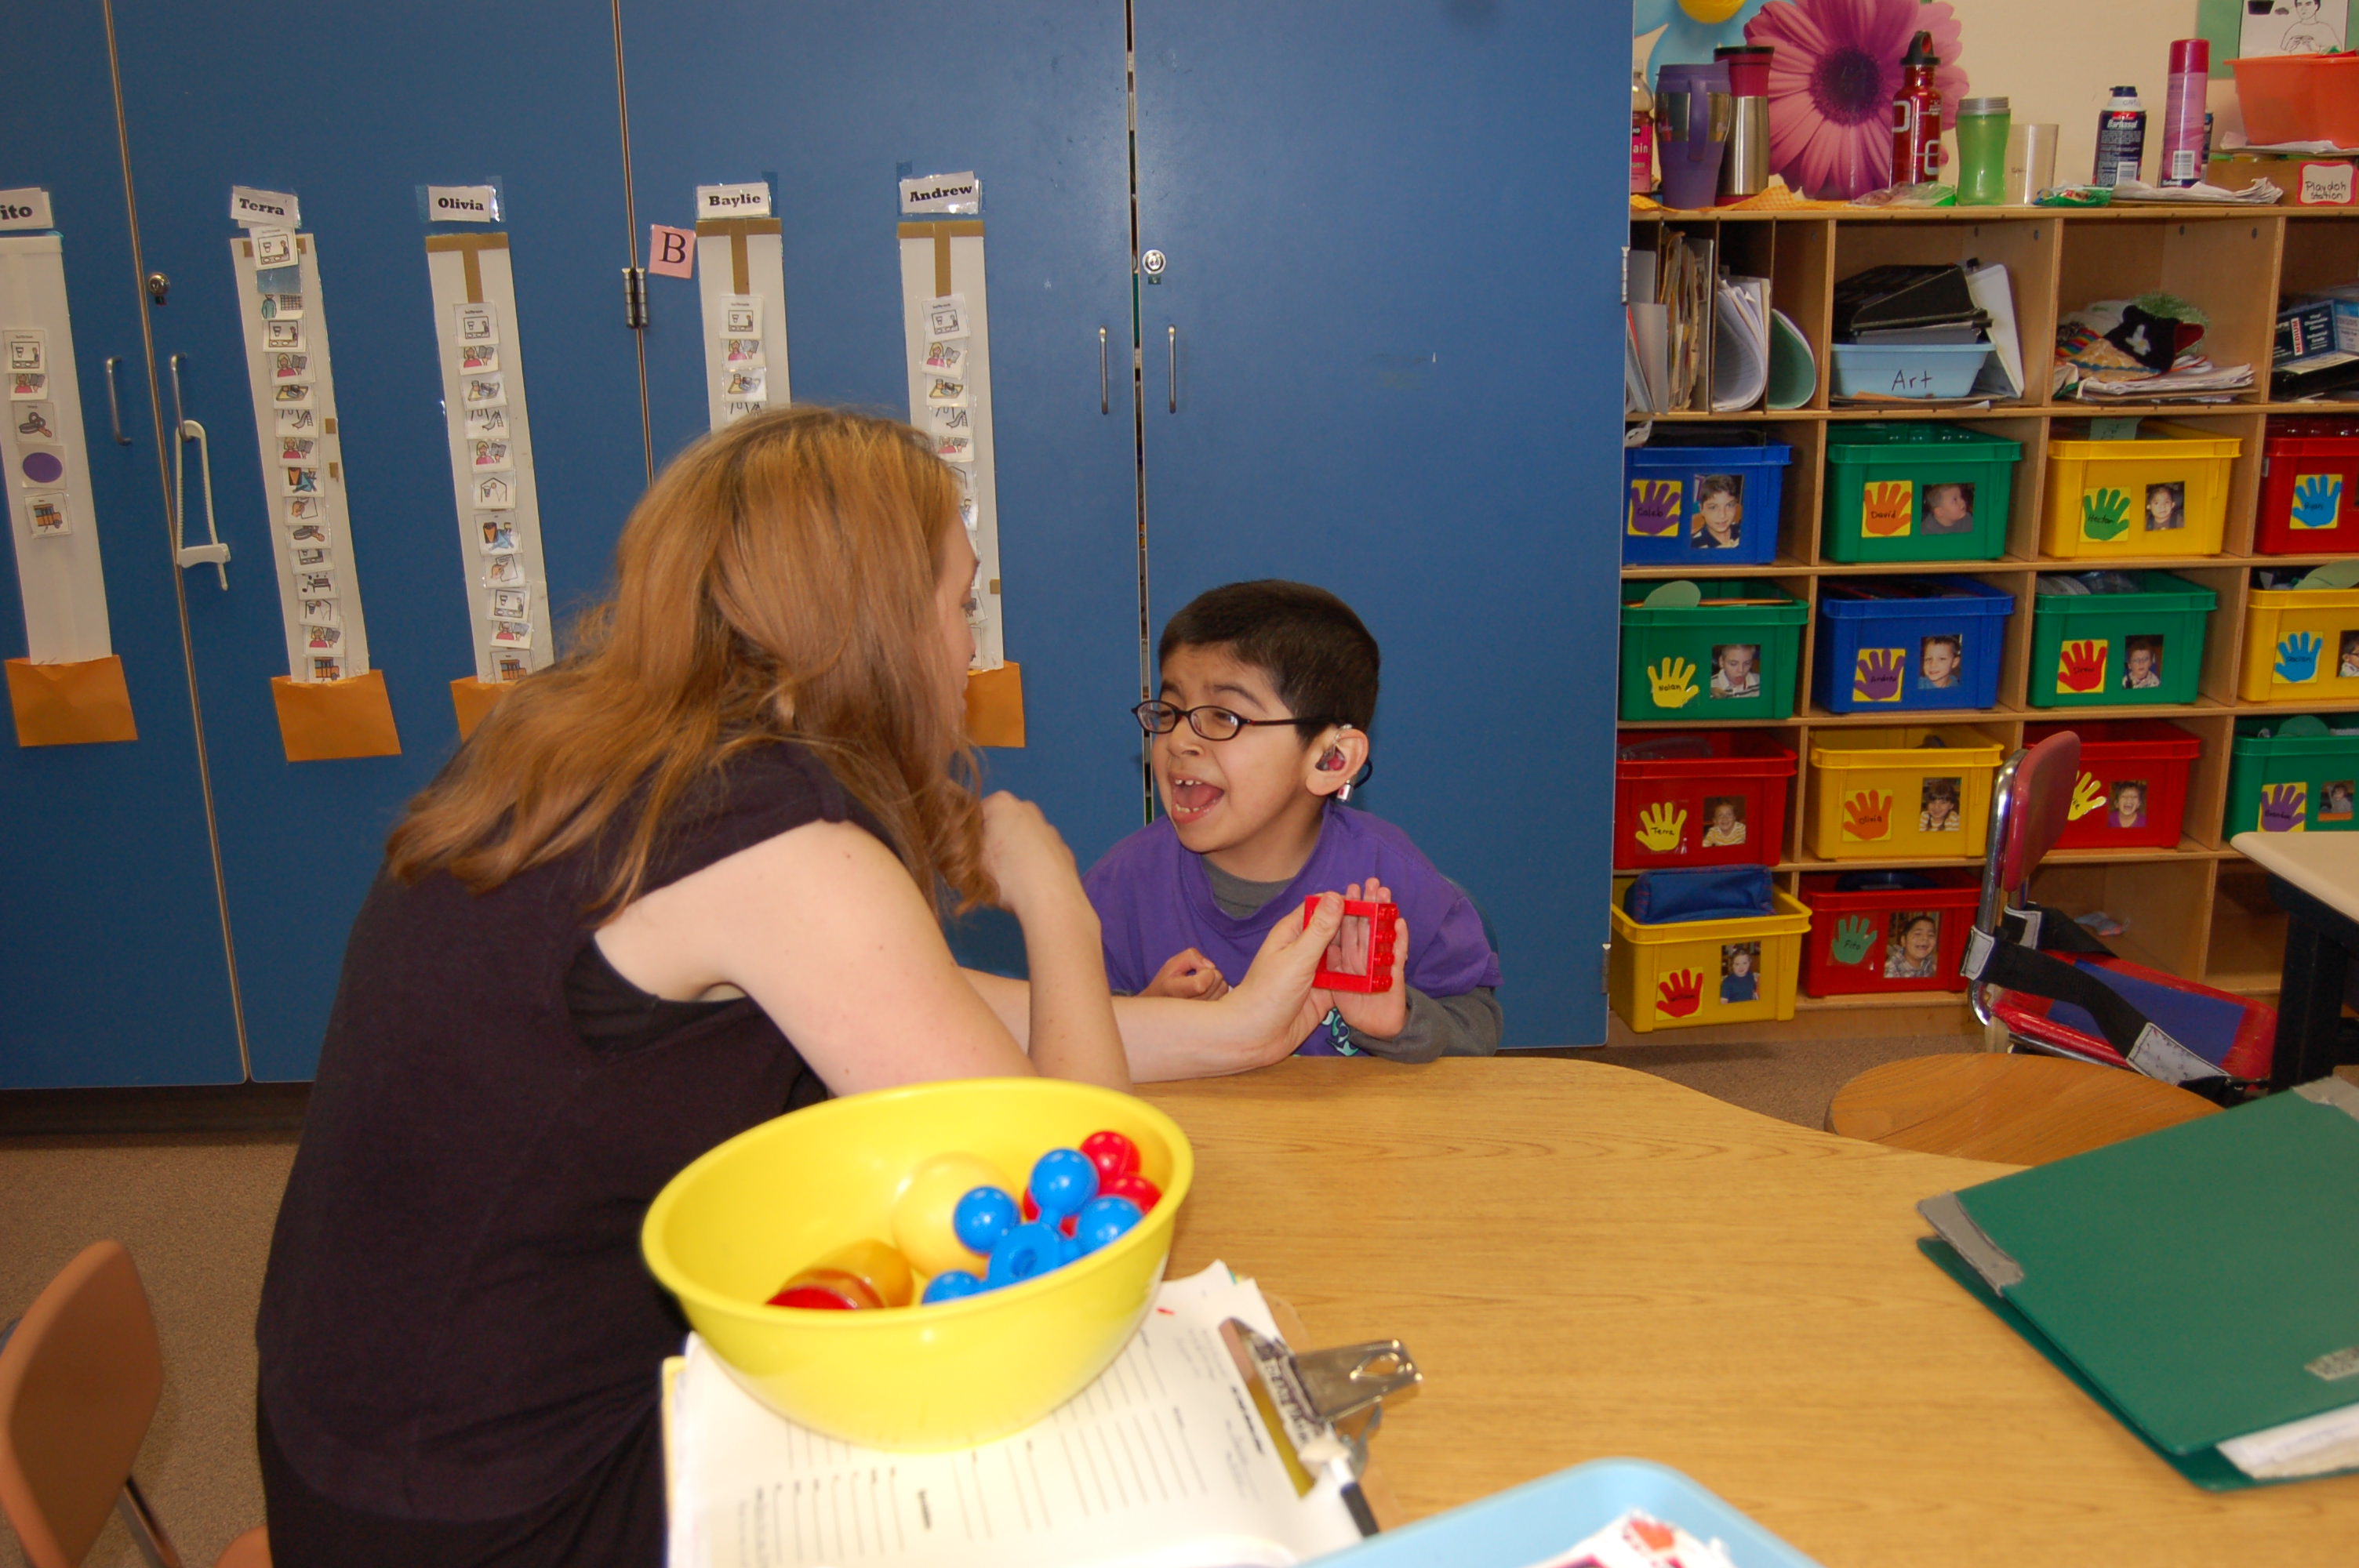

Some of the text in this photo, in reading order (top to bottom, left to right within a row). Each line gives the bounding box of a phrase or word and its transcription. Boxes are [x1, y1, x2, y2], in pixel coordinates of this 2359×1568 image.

[1632, 143, 1648, 154] ain
[910, 186, 972, 202] Andrew
[2305, 180, 2346, 194] Playdoh
[239, 198, 285, 216] Terra
[438, 197, 484, 211] Olivia
[709, 193, 761, 208] Baylie
[0, 205, 33, 220] ito
[659, 231, 686, 264] B
[2292, 320, 2302, 354] MEDIUM
[1892, 369, 1932, 391] Art
[1637, 506, 1663, 517] Caleb
[1870, 510, 1896, 519] David
[2088, 514, 2114, 524] Hector
[1658, 683, 1682, 691] Nolan
[1859, 814, 1882, 825] Olivia
[1651, 827, 1675, 836] Terra
[1844, 939, 1861, 950] Fito
